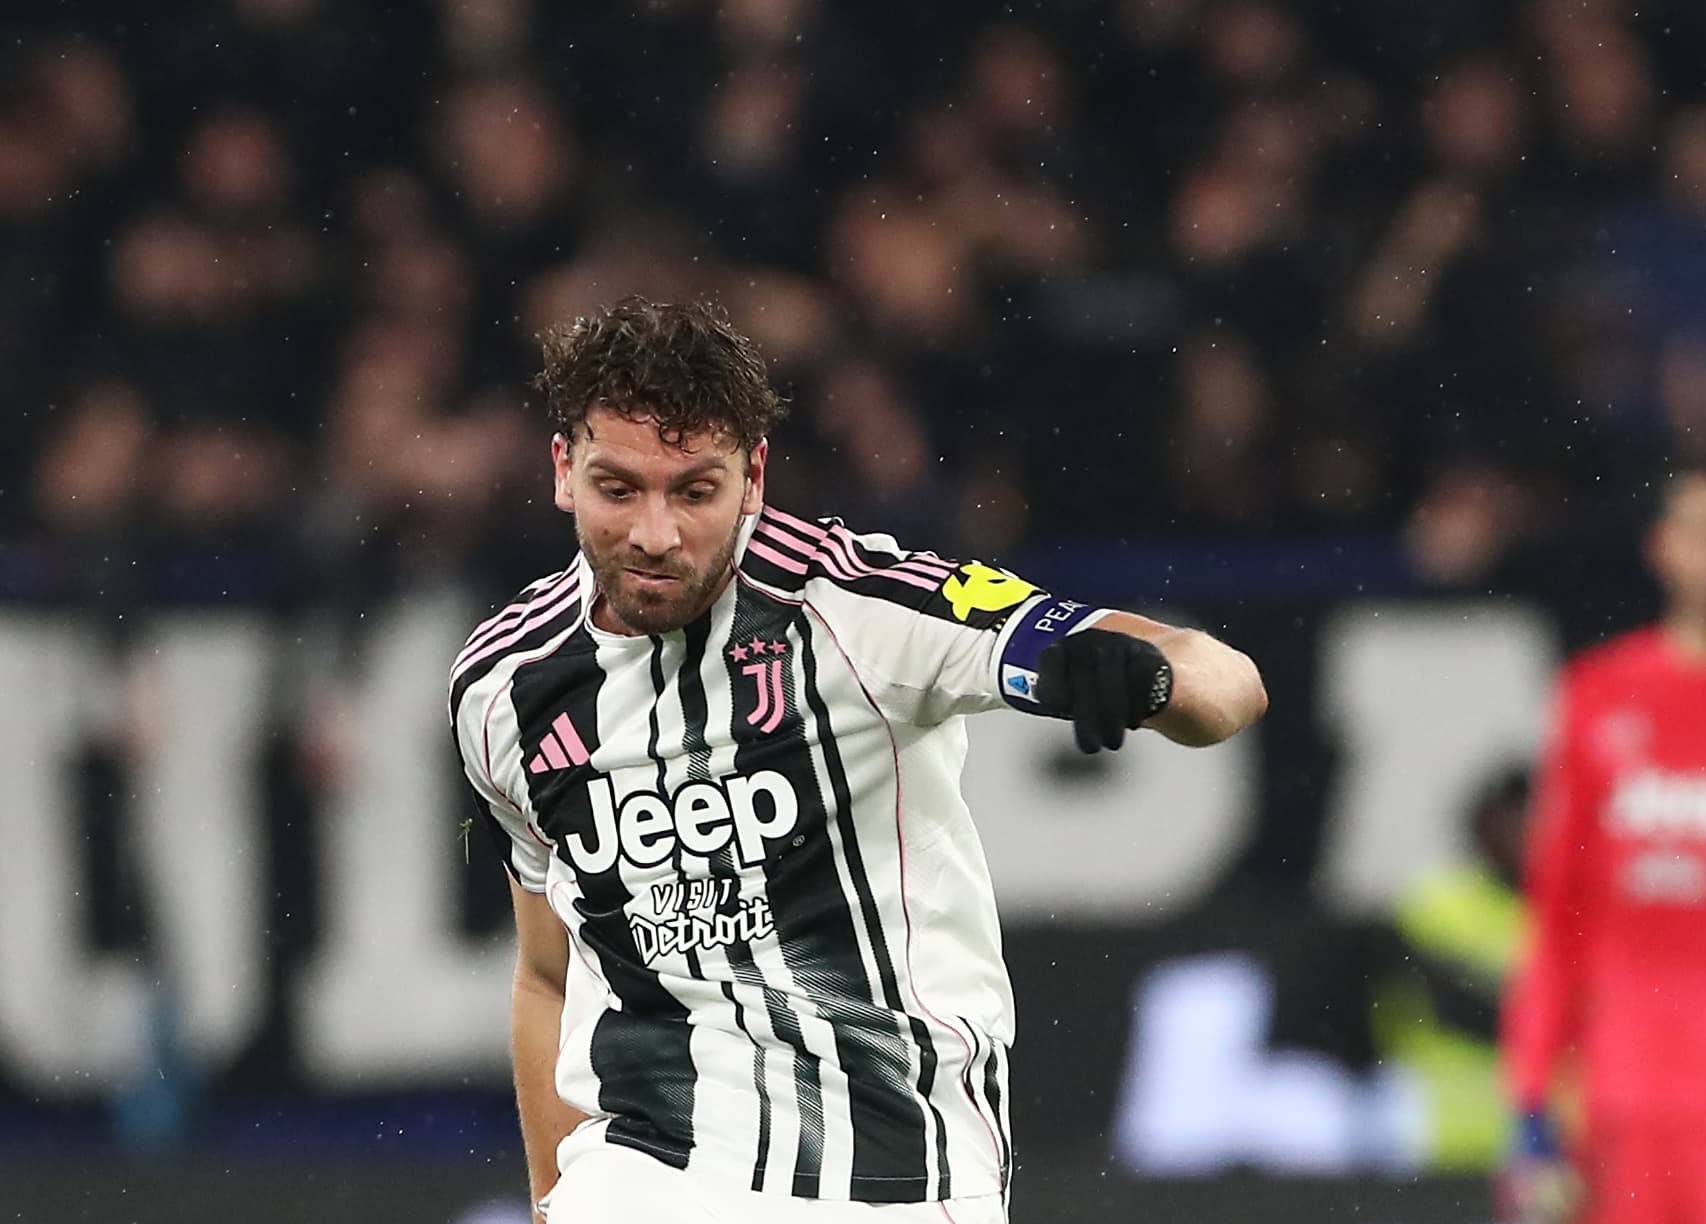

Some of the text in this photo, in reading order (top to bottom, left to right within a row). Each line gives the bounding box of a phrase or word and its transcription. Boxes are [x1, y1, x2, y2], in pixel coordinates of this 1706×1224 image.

[564, 769, 799, 875] Jeep
[629, 896, 776, 966] Detroit
[651, 877, 733, 917] VISIT
